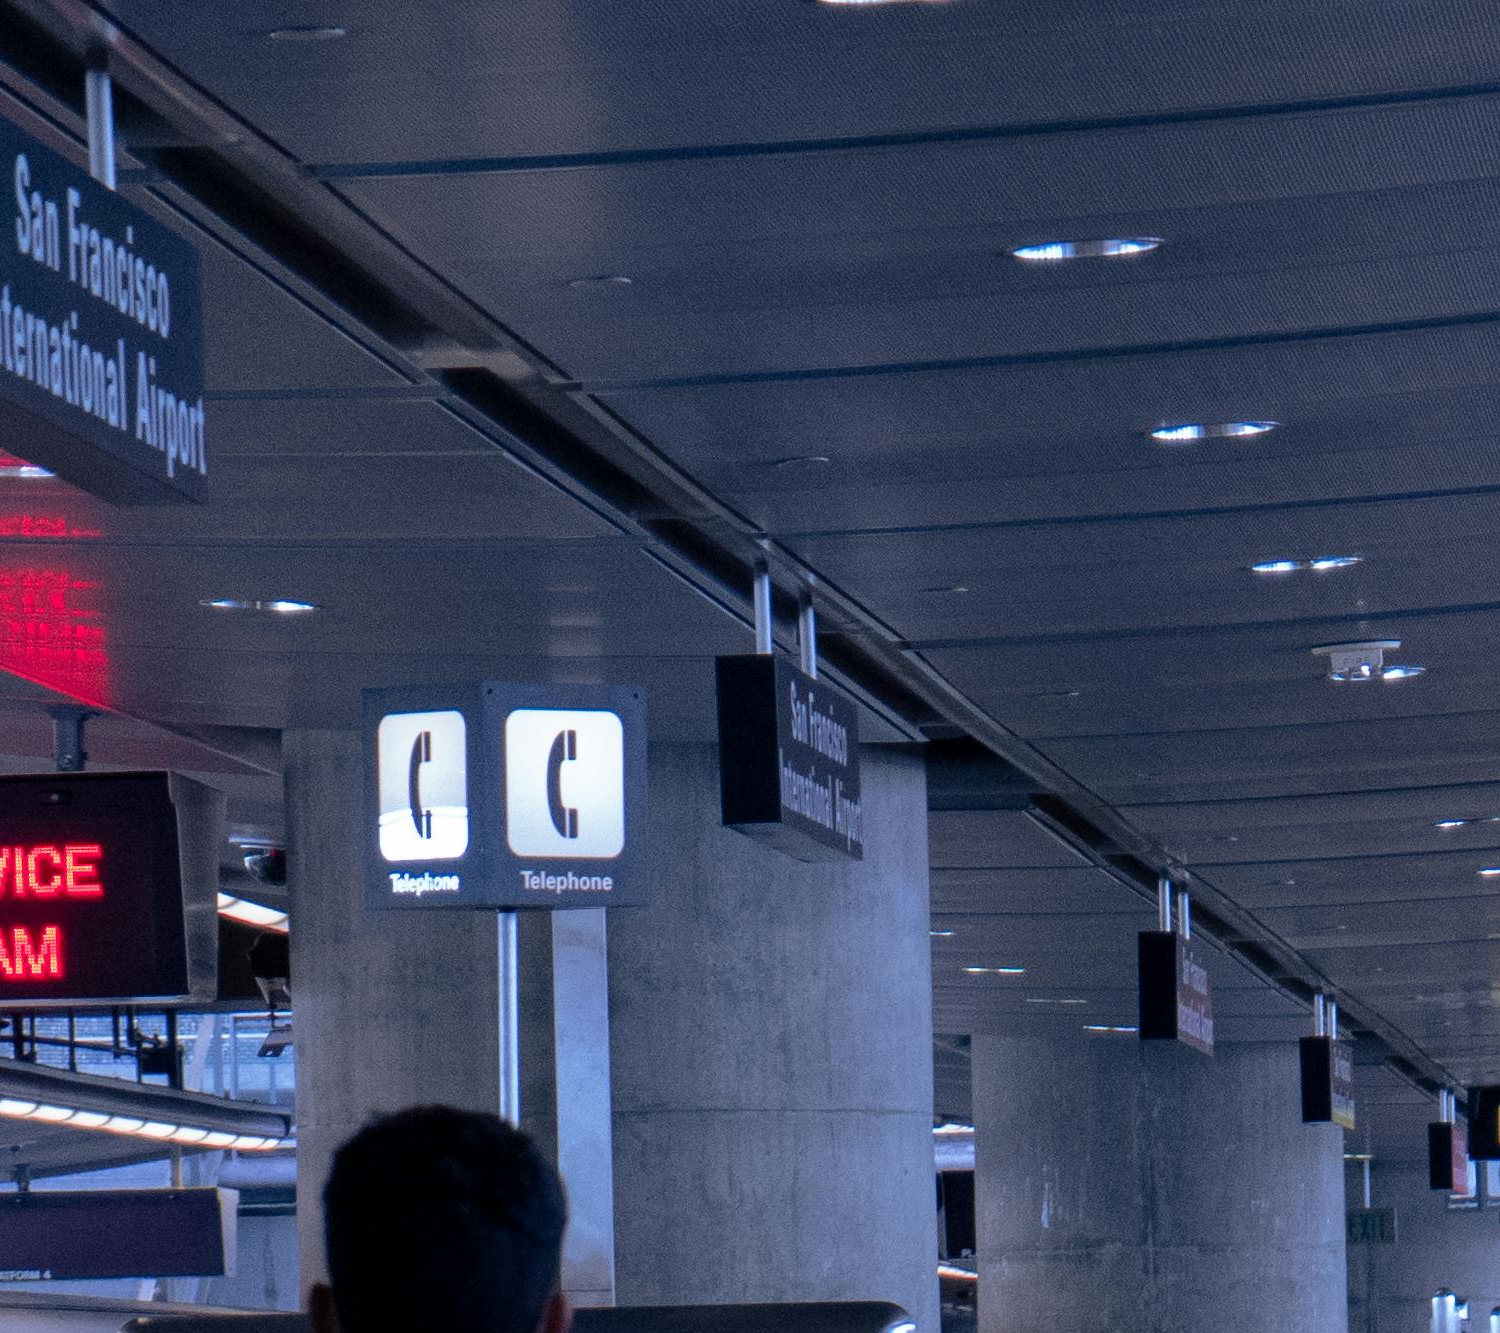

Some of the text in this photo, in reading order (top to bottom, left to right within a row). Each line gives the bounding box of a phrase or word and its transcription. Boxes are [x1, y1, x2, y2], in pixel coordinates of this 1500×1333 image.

[15, 154, 170, 339] San Francisco
[136, 350, 207, 479] Airport
[790, 681, 848, 767] San Francisco
[389, 873, 461, 896] Telephone
[520, 870, 613, 894] Telephone
